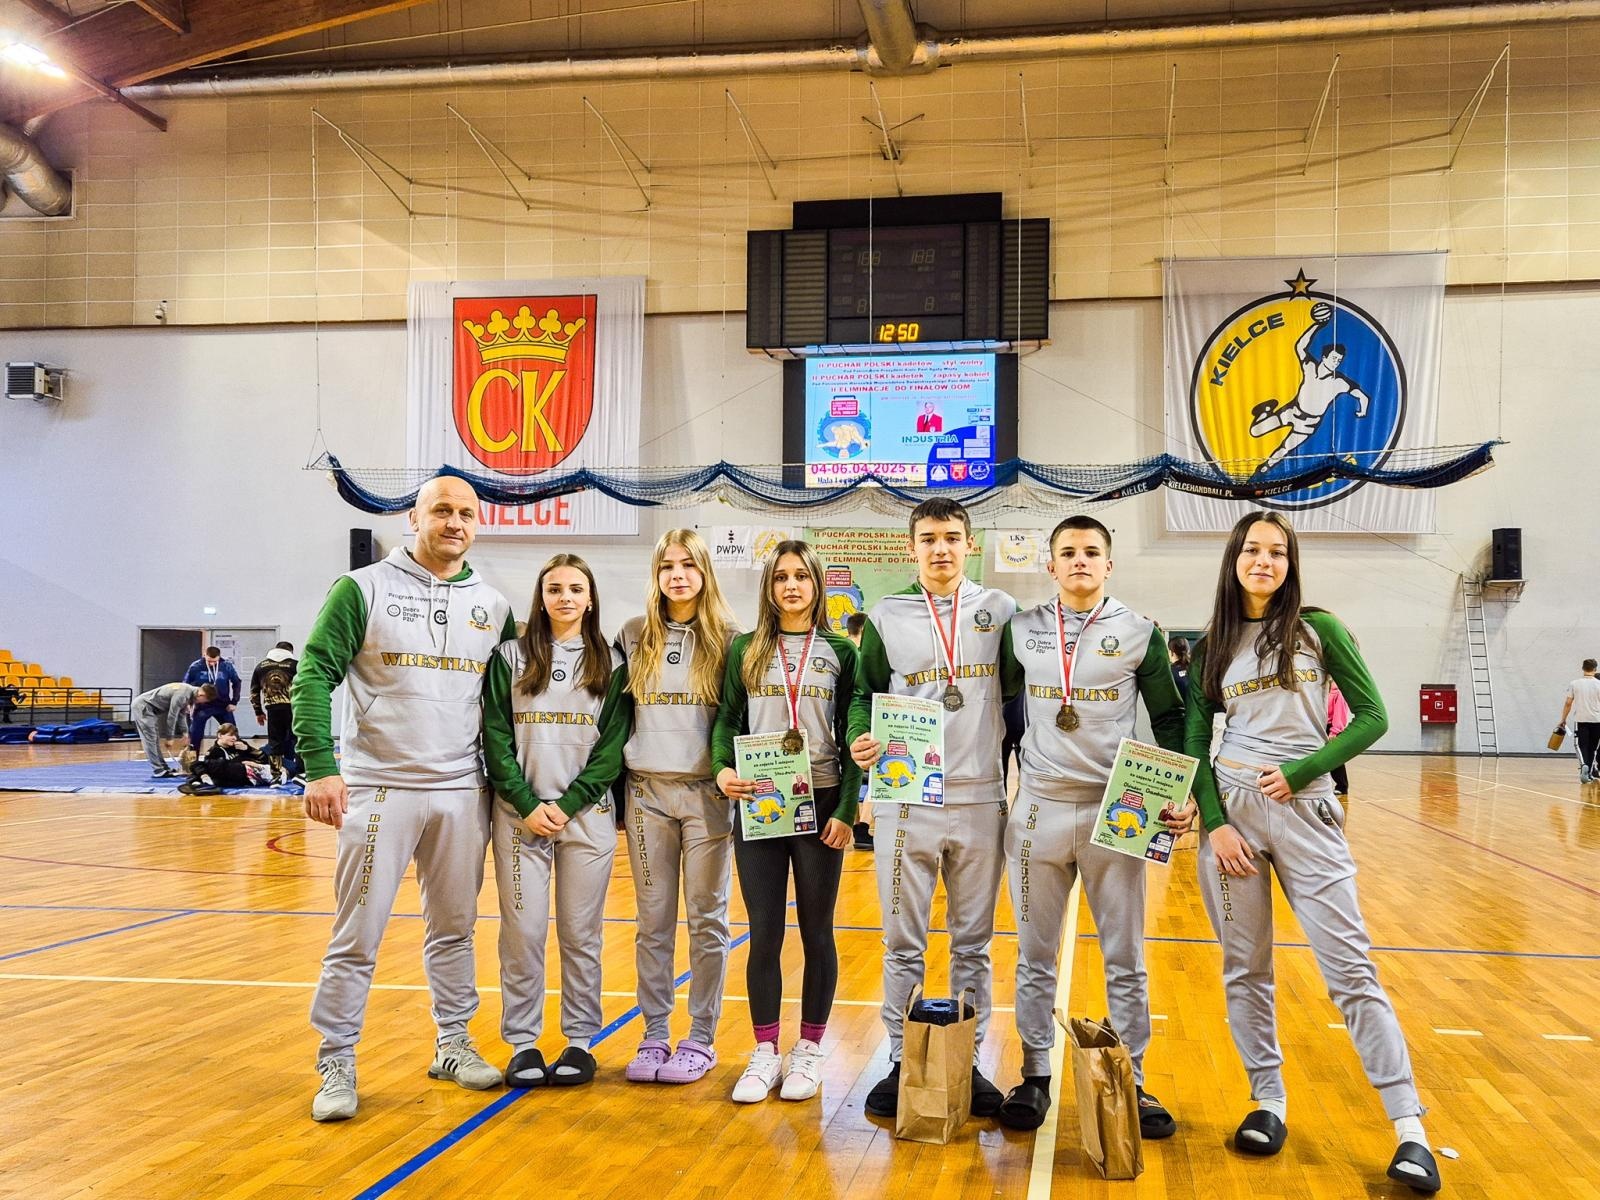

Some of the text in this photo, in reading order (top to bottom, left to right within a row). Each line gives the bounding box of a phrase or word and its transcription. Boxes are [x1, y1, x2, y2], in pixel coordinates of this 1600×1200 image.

[1210, 312, 1284, 386] KIELCE
[467, 368, 568, 453] CK
[902, 434, 958, 443] INDUSTRIA
[811, 464, 906, 475] 04-06.04.2025
[1121, 482, 1148, 497] KIELCE
[479, 497, 570, 525] IELCE
[716, 545, 745, 555] PWPW
[1029, 684, 1119, 701] WRESTLING
[514, 712, 596, 726] WRESTLIN
[882, 712, 936, 725] DYPLOM
[746, 751, 800, 760] DYPLO
[1125, 760, 1184, 783] DYPLOM
